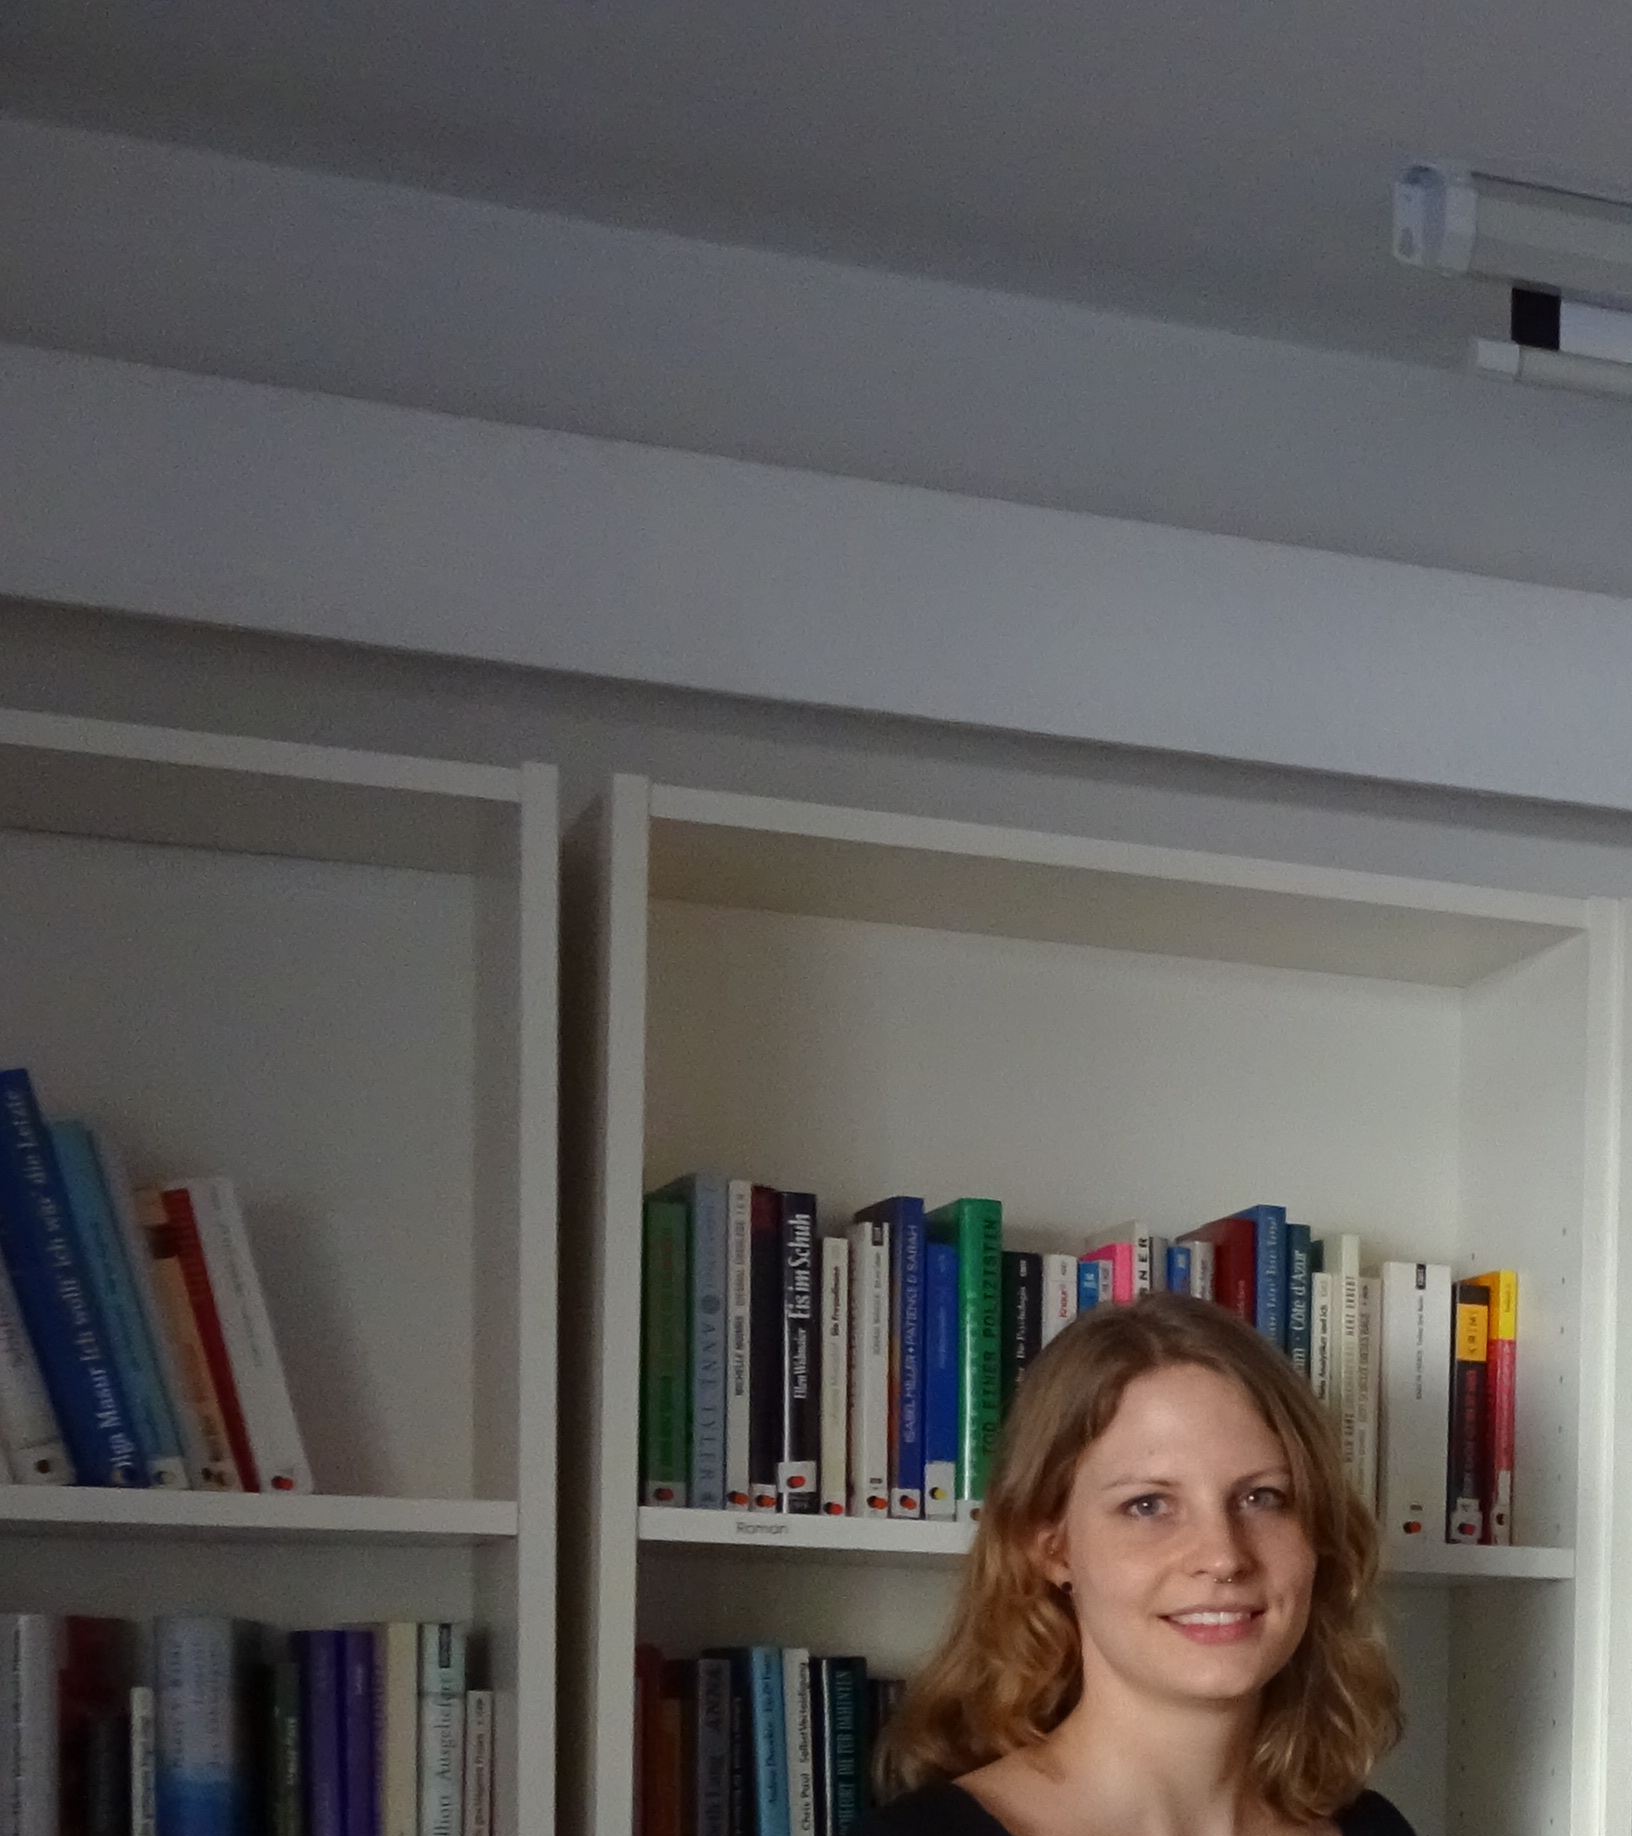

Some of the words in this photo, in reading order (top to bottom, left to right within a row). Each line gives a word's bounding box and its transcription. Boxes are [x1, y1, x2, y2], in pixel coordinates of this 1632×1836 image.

[786, 1213, 811, 1268] Schuh
[788, 1269, 811, 1292] im
[982, 1218, 999, 1338] POLIZISTIN
[1289, 1249, 1307, 1296] d'Azur
[788, 1294, 812, 1320] Eis
[1289, 1299, 1307, 1332] Côte
[982, 1350, 998, 1409] EINER
[982, 1420, 998, 1456] TOD
[736, 1521, 788, 1536] Roman
[799, 1773, 810, 1799] Paul
[800, 1802, 812, 1832] Chris
